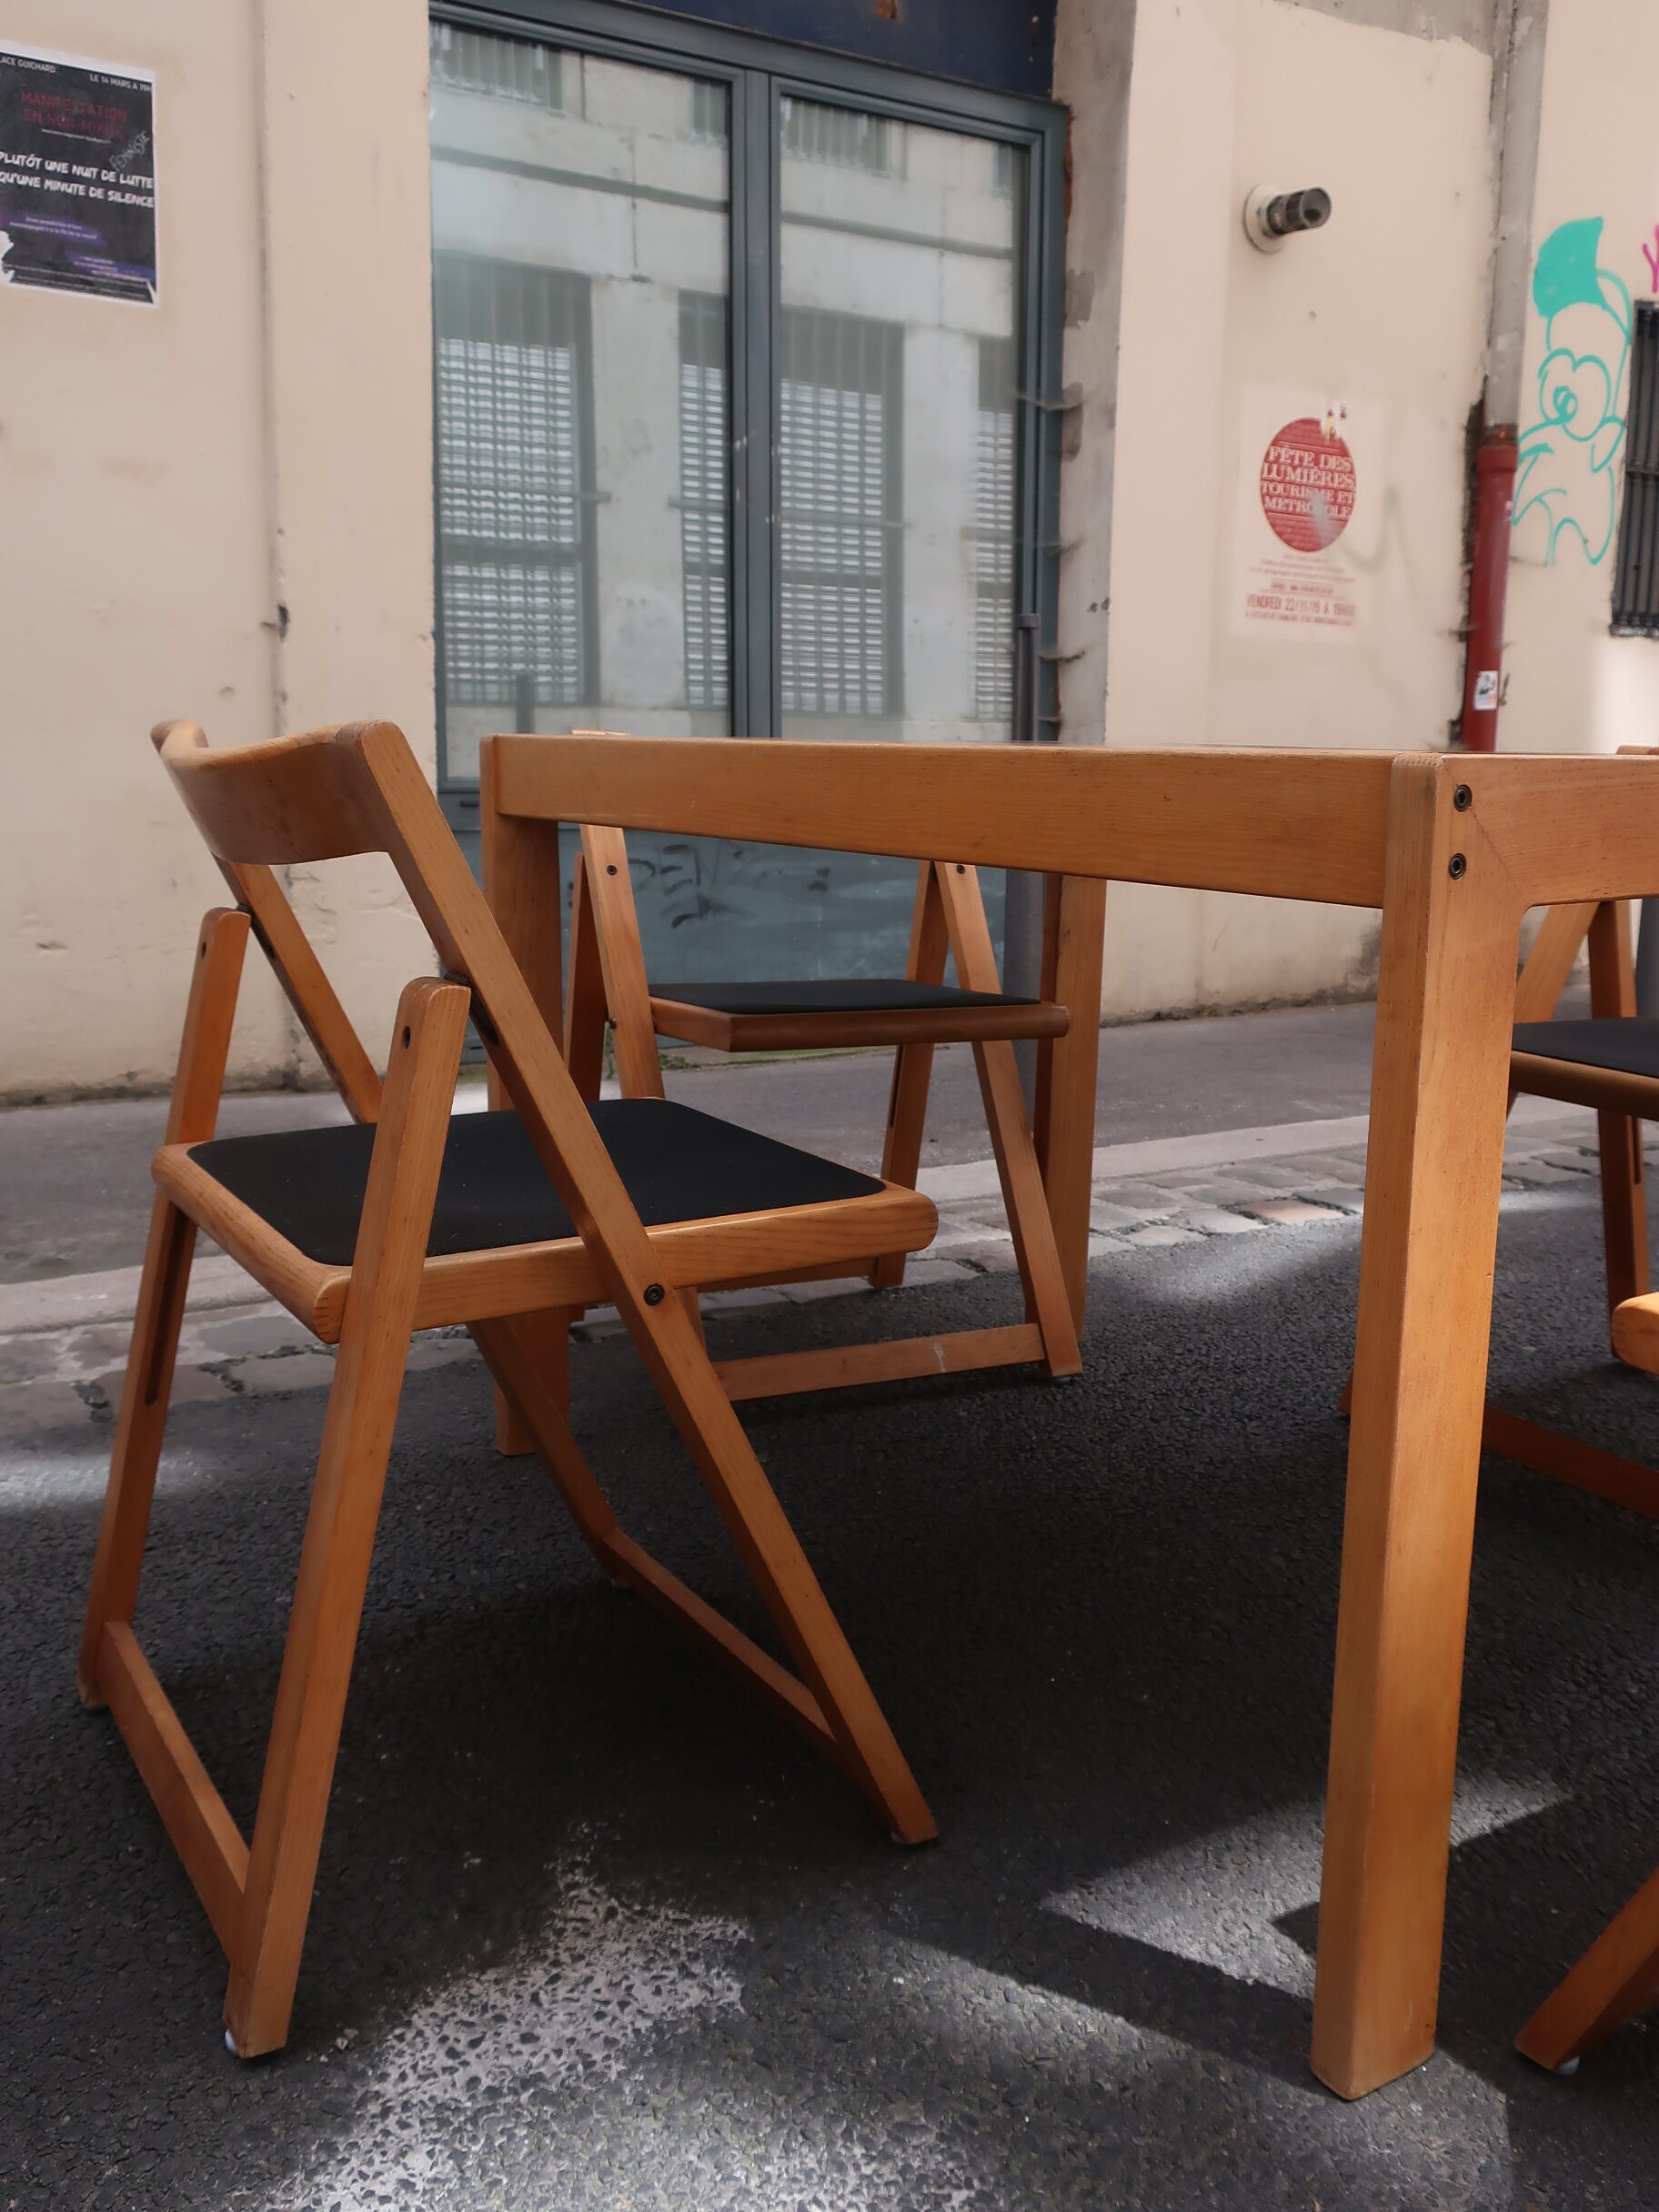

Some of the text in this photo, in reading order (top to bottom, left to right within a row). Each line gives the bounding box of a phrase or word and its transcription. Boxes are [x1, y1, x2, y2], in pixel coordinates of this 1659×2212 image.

[0, 56, 56, 73] ACE GUICHARD
[89, 74, 99, 83] LE
[110, 78, 132, 89] MARS
[45, 160, 69, 175] UNE
[72, 165, 98, 180] NUIT
[101, 169, 116, 183] DE
[119, 173, 154, 189] LUTTE
[0, 171, 154, 208] QU'UNE MINUTE DE SILENCE
[1269, 444, 1352, 472] FÊTE DES
[1262, 463, 1355, 489] LUMIÈRES
[1263, 496, 1352, 518] METROOLE
[1338, 491, 1356, 504] ET
